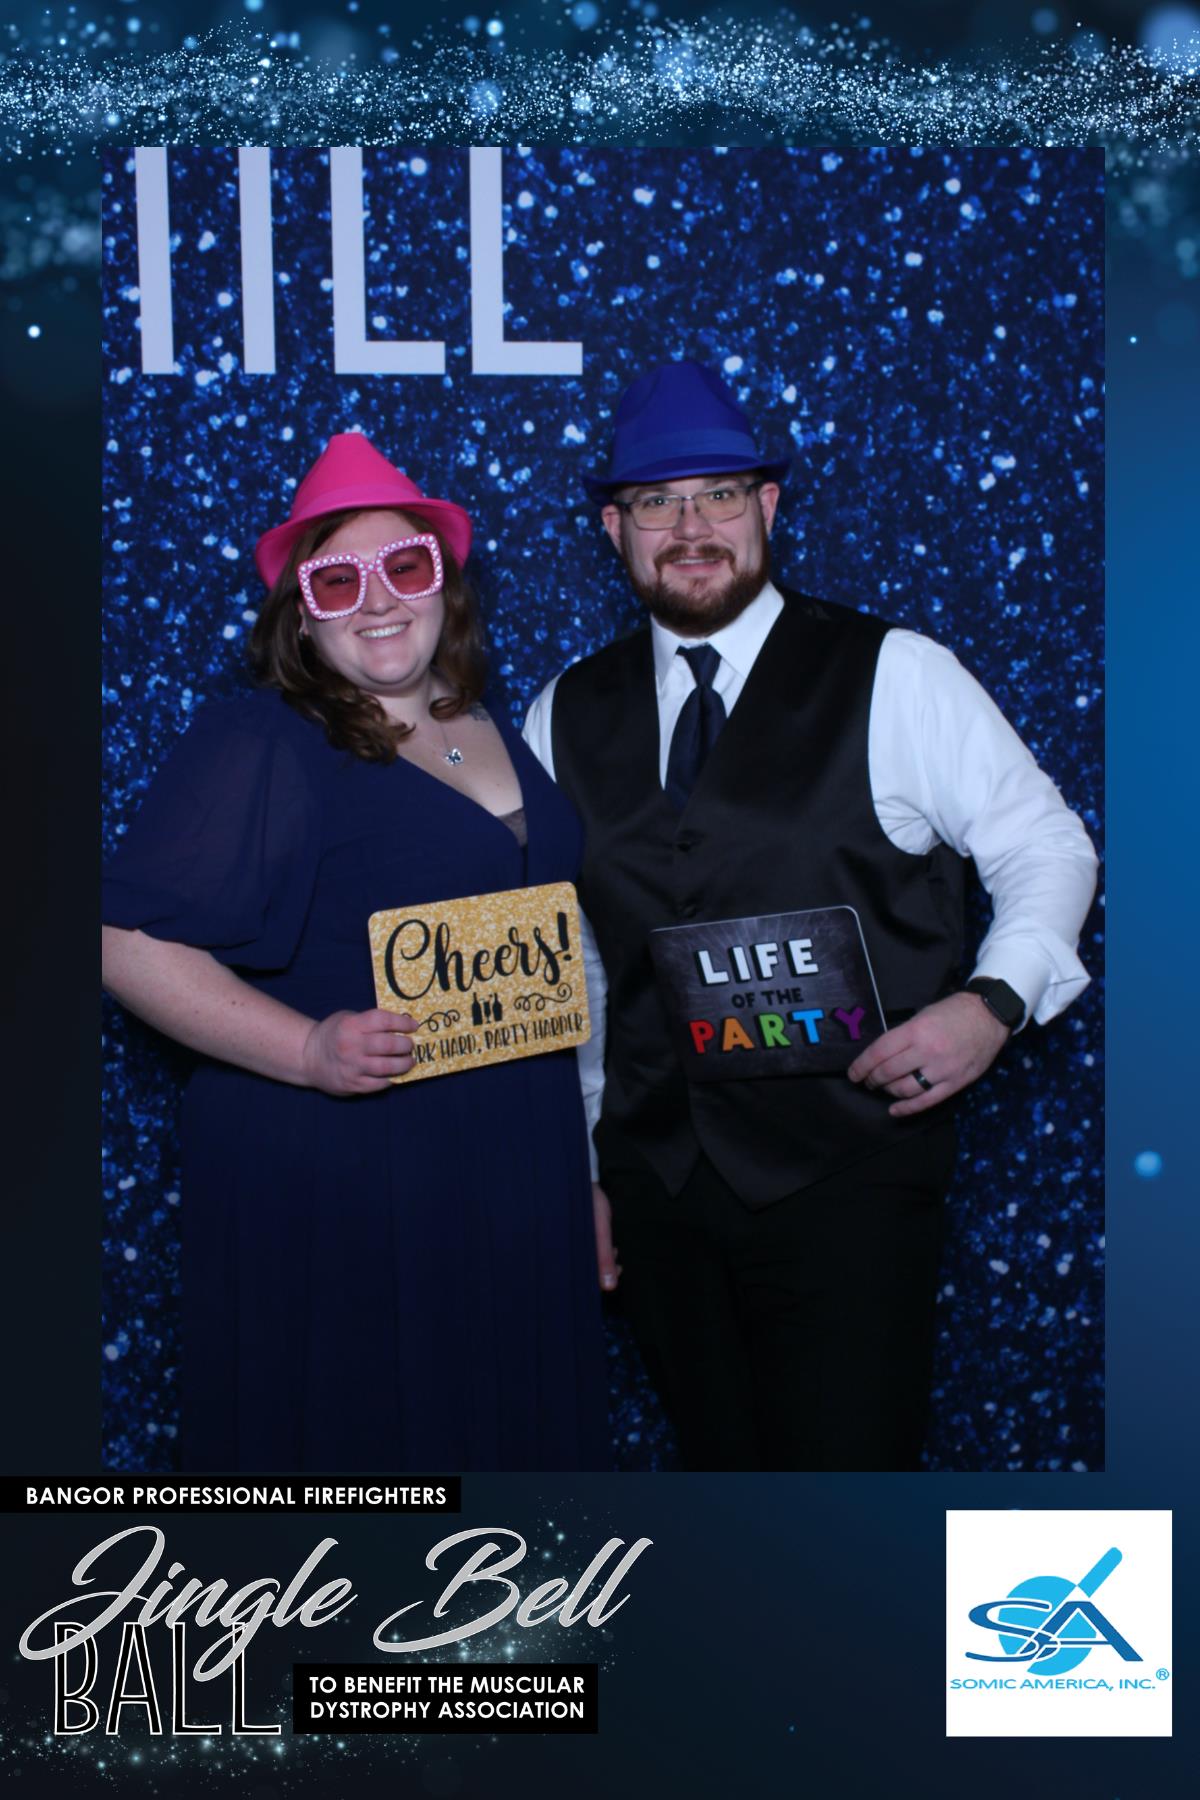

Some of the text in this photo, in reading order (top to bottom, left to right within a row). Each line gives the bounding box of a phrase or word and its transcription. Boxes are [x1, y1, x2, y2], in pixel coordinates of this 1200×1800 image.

[384, 911, 573, 1001] Cheers!
[696, 938, 819, 985] LIFE
[731, 987, 804, 1009] OF THE
[484, 1020, 529, 1050] PARTY
[532, 1012, 583, 1040] HARDER
[688, 1006, 866, 1054] PARTY
